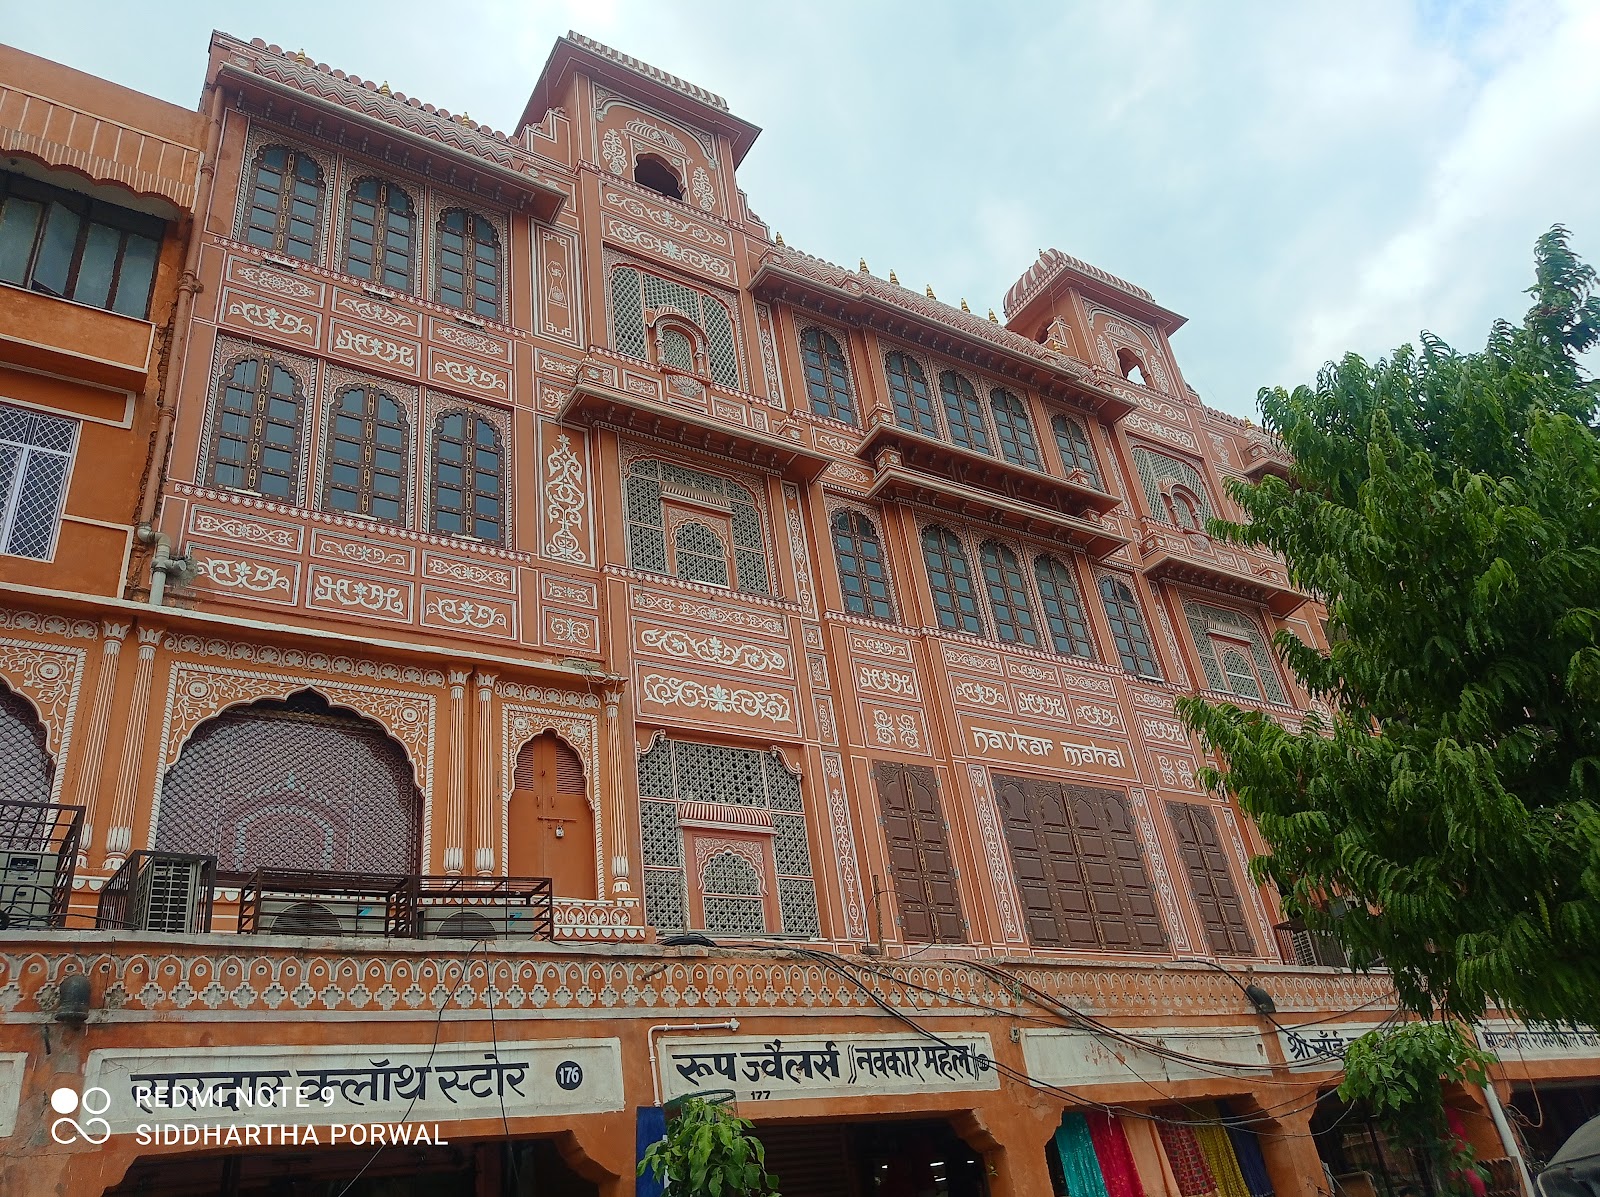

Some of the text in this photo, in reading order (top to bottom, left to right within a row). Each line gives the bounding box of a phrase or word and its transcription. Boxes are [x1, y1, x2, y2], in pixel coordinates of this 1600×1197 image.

[971, 727, 1126, 768] navkar mahal
[296, 1058, 432, 1105] क्लॉथ
[435, 1053, 530, 1103] स्टोर
[559, 1066, 580, 1085] 176
[672, 1052, 738, 1087] रूप
[750, 1090, 771, 1100] 177
